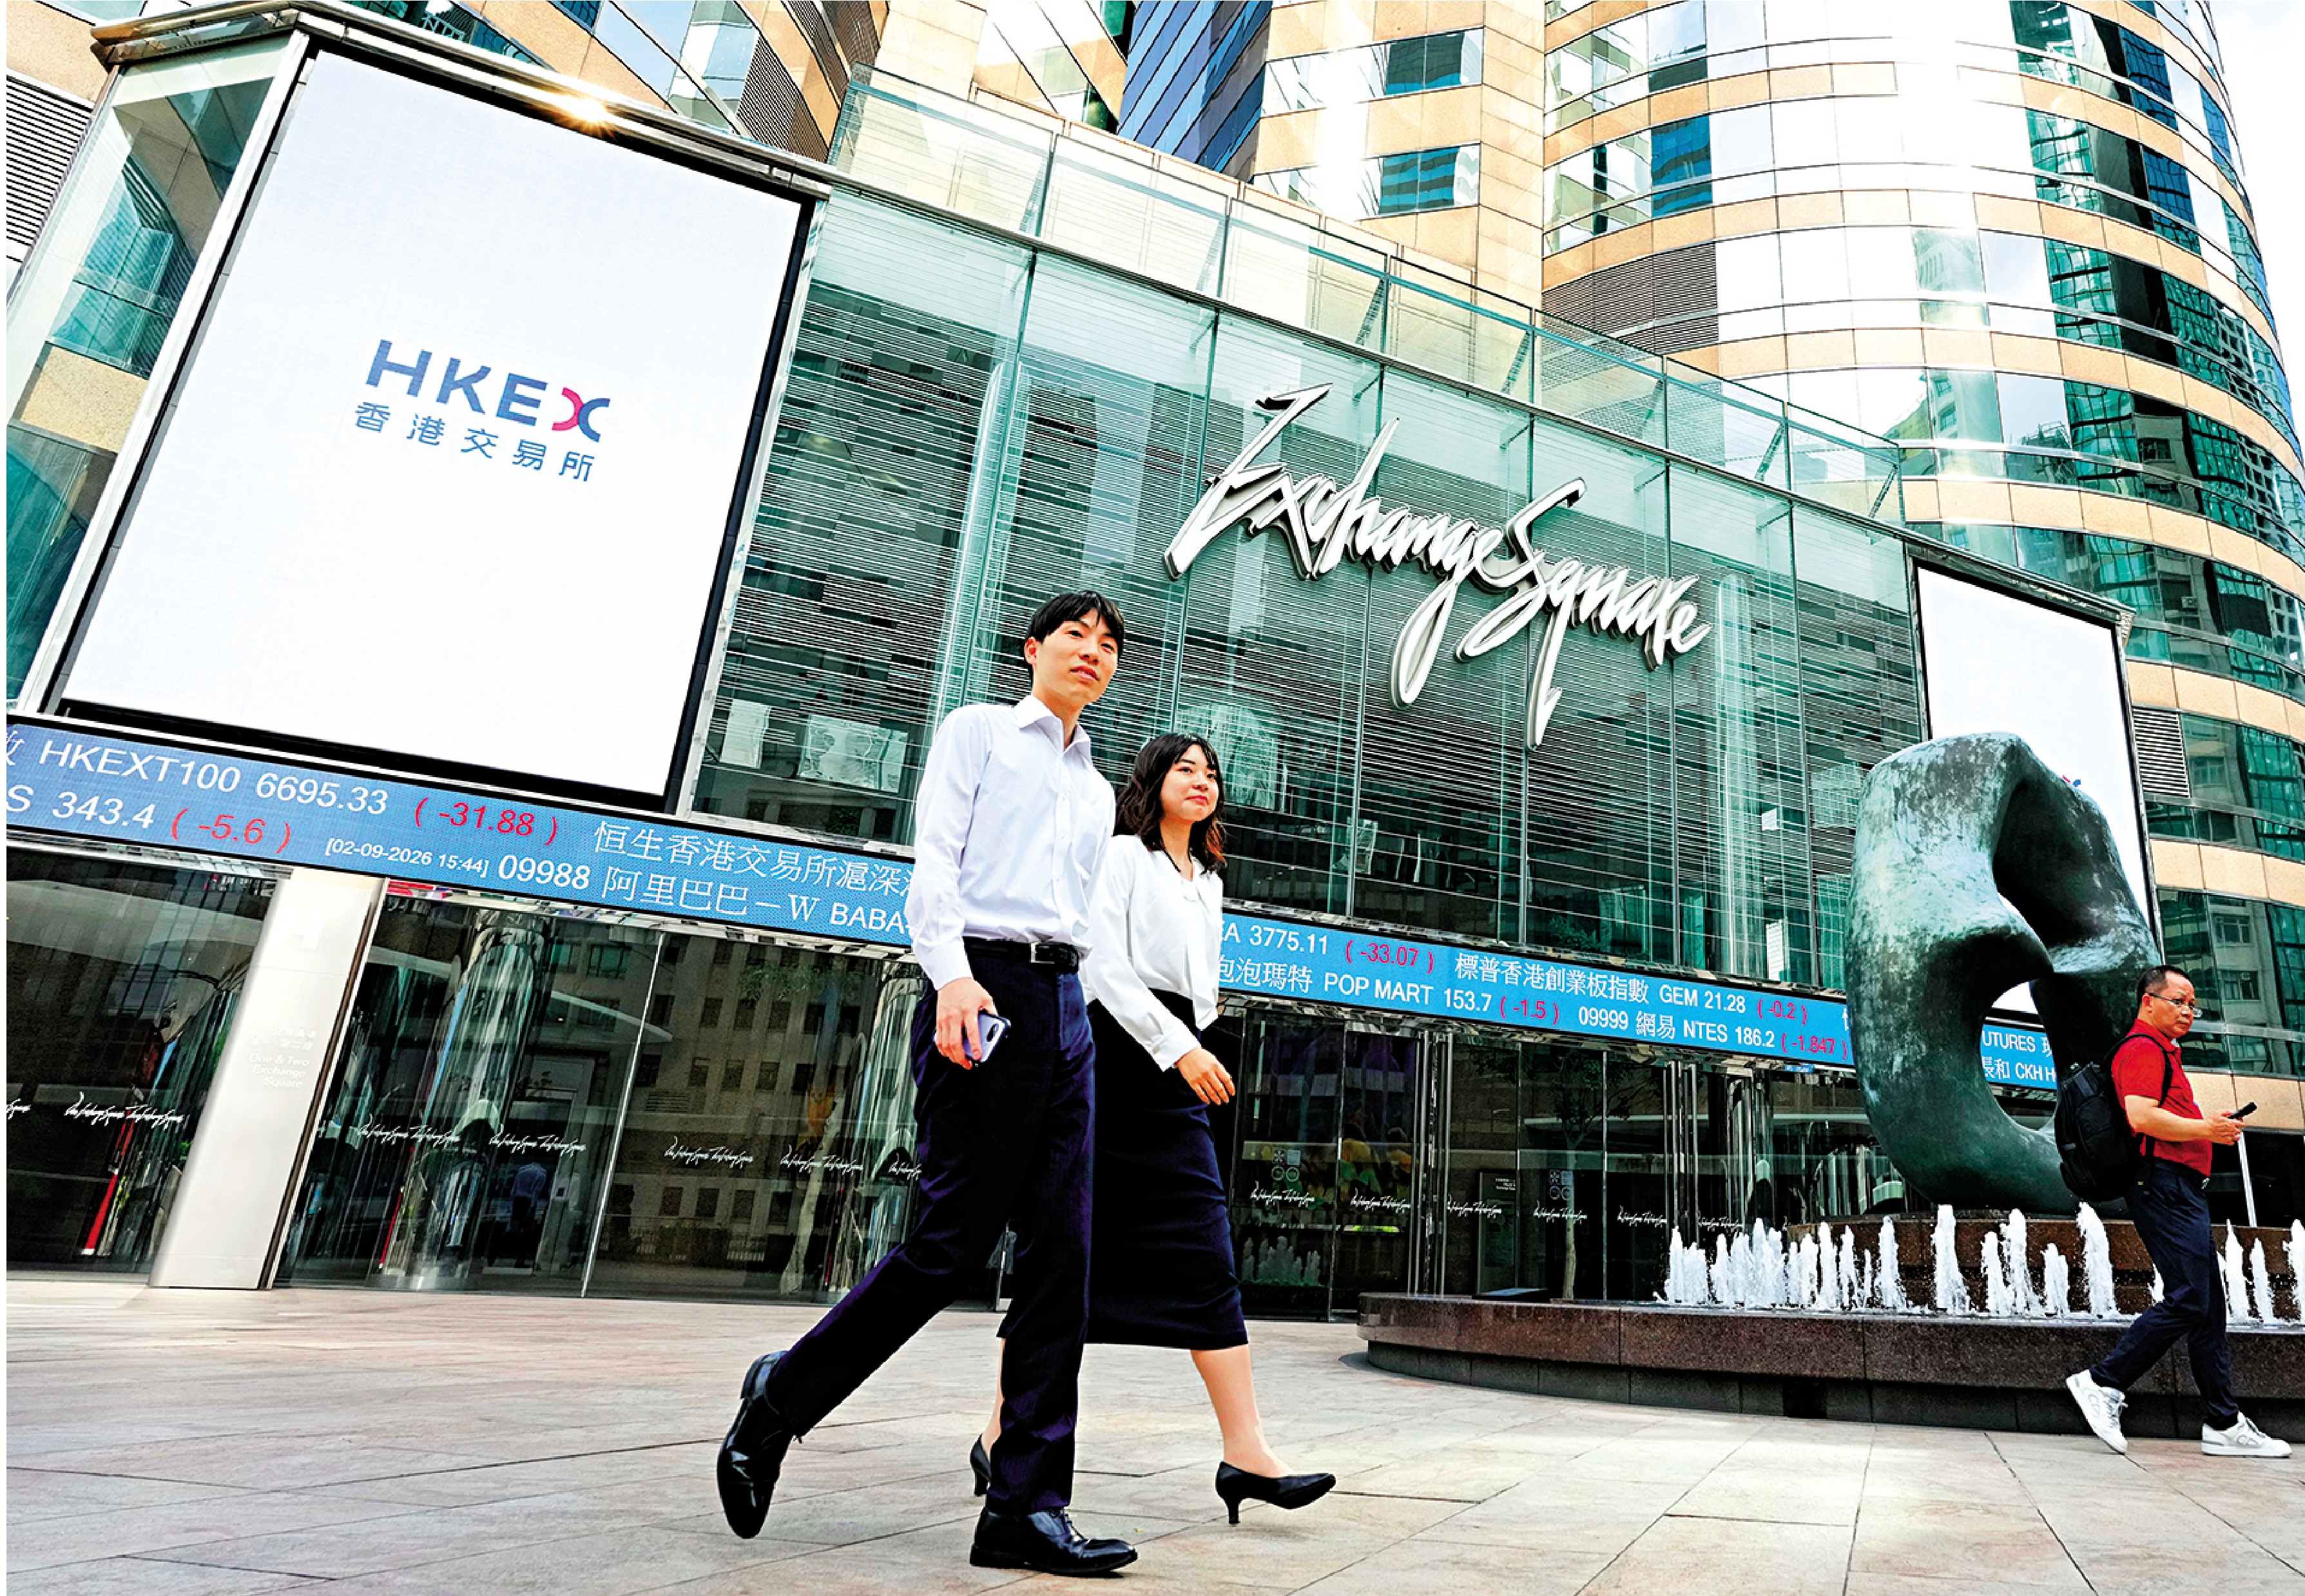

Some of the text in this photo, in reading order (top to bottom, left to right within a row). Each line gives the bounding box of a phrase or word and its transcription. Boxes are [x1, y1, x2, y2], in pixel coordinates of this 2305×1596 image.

[365, 340, 610, 443] HKEX
[355, 402, 595, 481] 香港交易所
[1163, 383, 1713, 751] Exchange Square
[39, 741, 241, 792] HKEXT100
[257, 773, 388, 814] 6695.33
[594, 821, 910, 898] 恒生香港交易所滬深
[53, 792, 156, 829] 343.4
[325, 839, 432, 865] [02-09-2026
[439, 854, 489, 878] 15:44]
[499, 856, 590, 889] 09988
[1250, 925, 1327, 955] 3775.11
[1456, 953, 1649, 1003] 標普香港創業板指數
[1660, 984, 1697, 1006] GEM
[1704, 991, 1746, 1014] 21.28
[1325, 973, 1369, 995] POP
[1375, 979, 1434, 1005] MART
[1445, 989, 1492, 1012] 153.7
[1579, 1006, 1628, 1030] 09999
[1636, 1011, 1675, 1039] 網易
[1684, 1020, 1728, 1043] NTES
[1735, 1027, 1775, 1048] 186.2
[1982, 1031, 2036, 1052] UTURES
[2015, 1062, 2043, 1081] CKH
